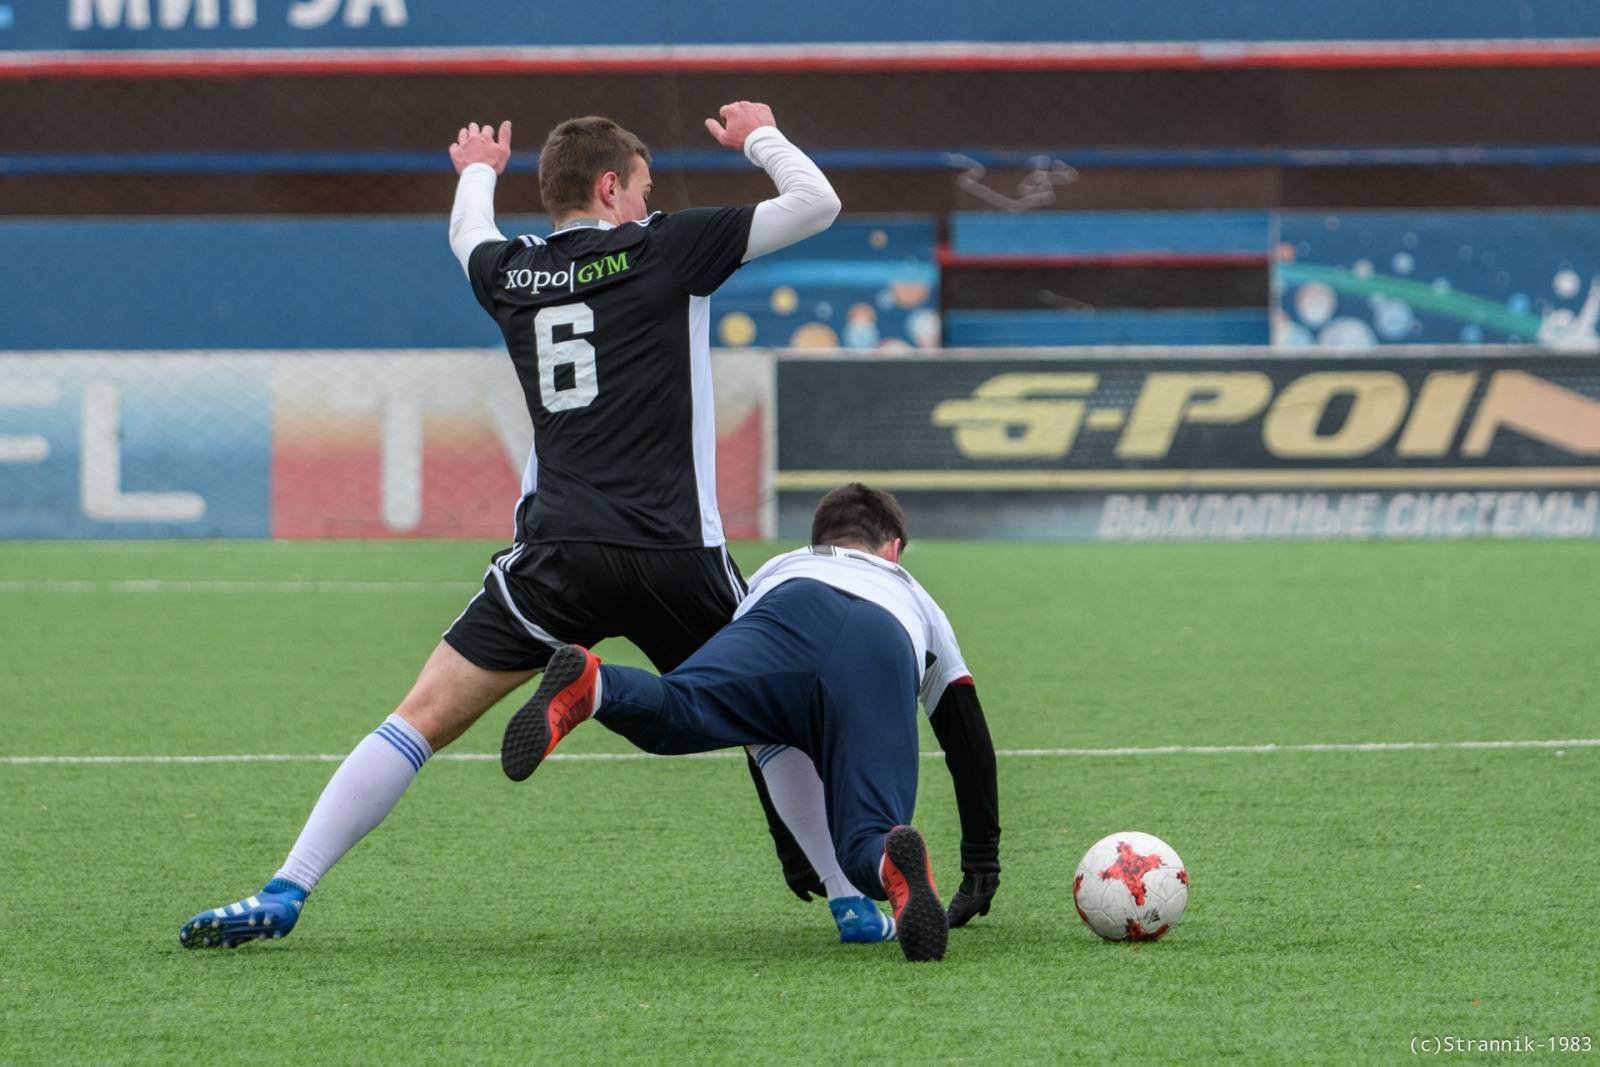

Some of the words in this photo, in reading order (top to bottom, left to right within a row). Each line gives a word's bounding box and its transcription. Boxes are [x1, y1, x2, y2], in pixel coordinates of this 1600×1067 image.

[534, 302, 599, 413] 6
[1101, 493, 1382, 538] ВЫХЛОПНЫЕ
[1386, 491, 1600, 537] СИСТЕМЫ
